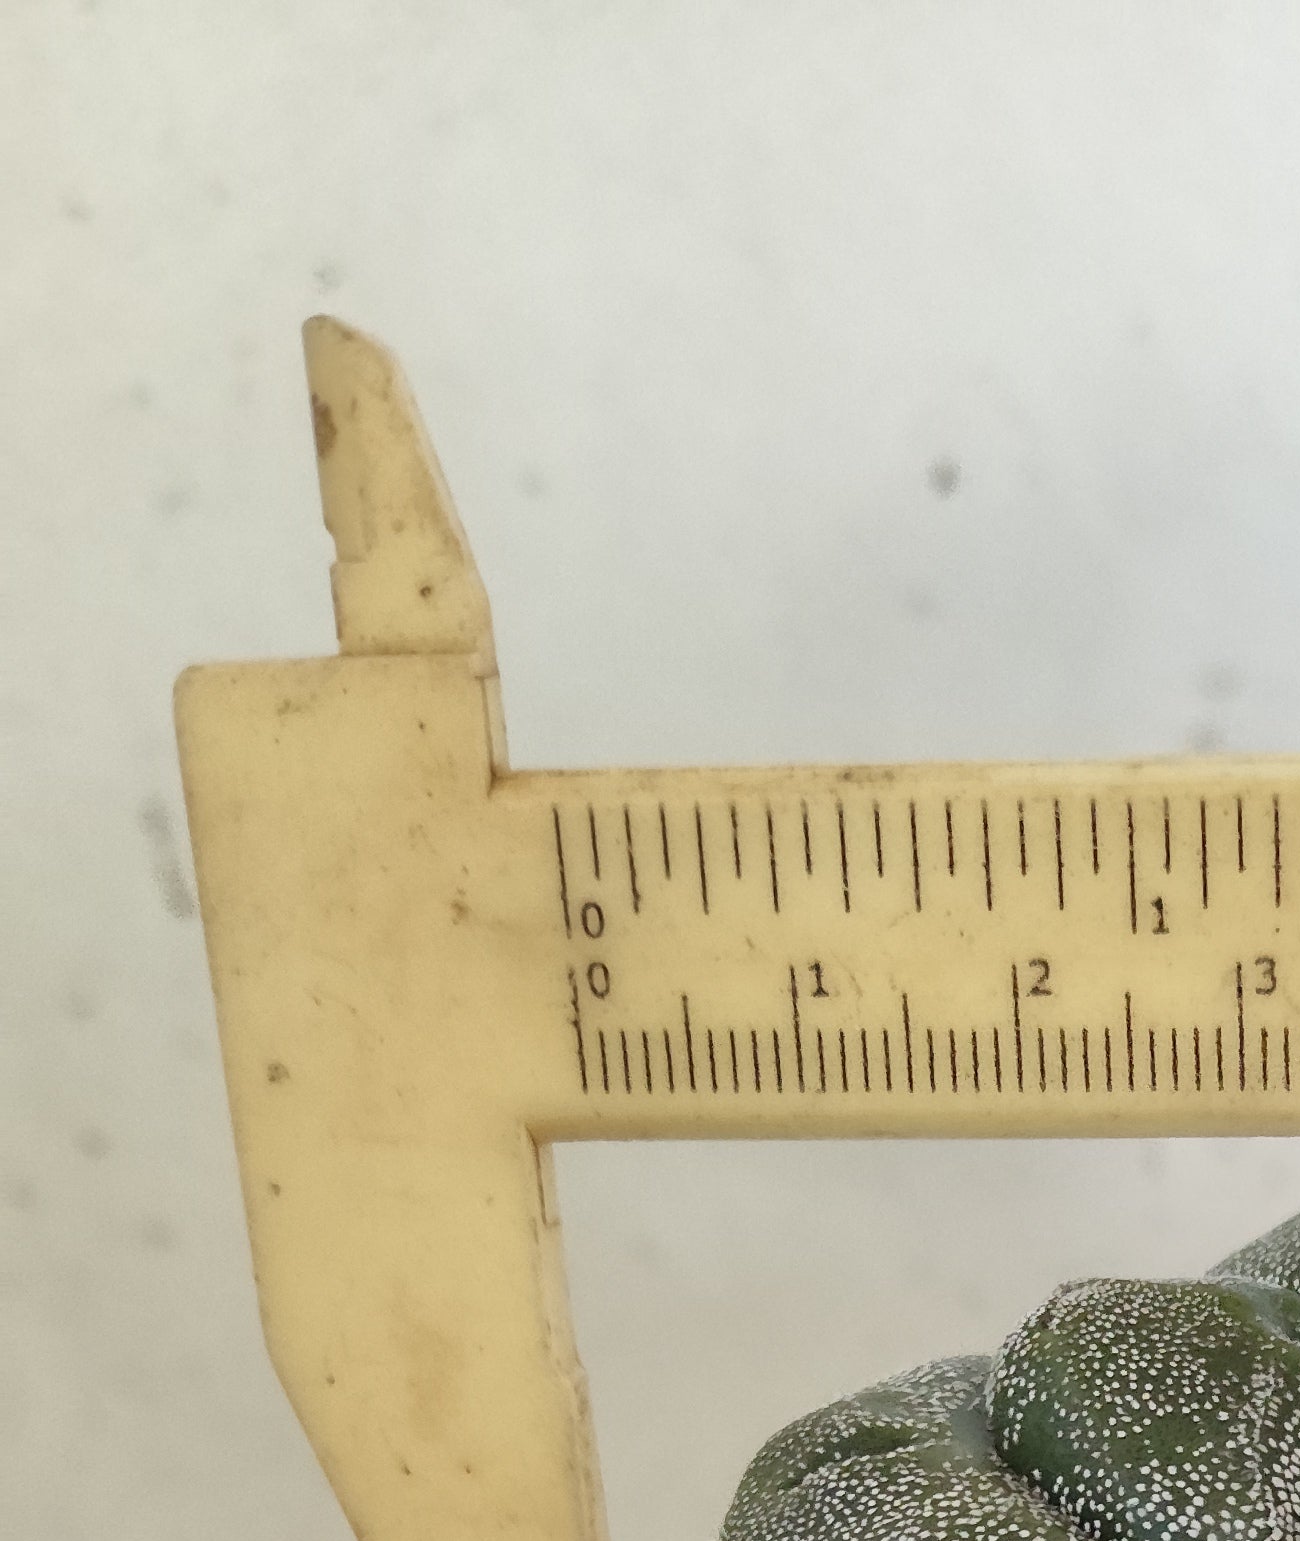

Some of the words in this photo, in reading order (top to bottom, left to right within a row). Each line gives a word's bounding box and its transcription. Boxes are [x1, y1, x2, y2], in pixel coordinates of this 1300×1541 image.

[580, 900, 605, 940] 0
[1150, 896, 1170, 934] 1
[587, 961, 611, 999] 0
[807, 960, 830, 998] 1
[1026, 958, 1052, 997] 2
[1254, 956, 1278, 996] 3
